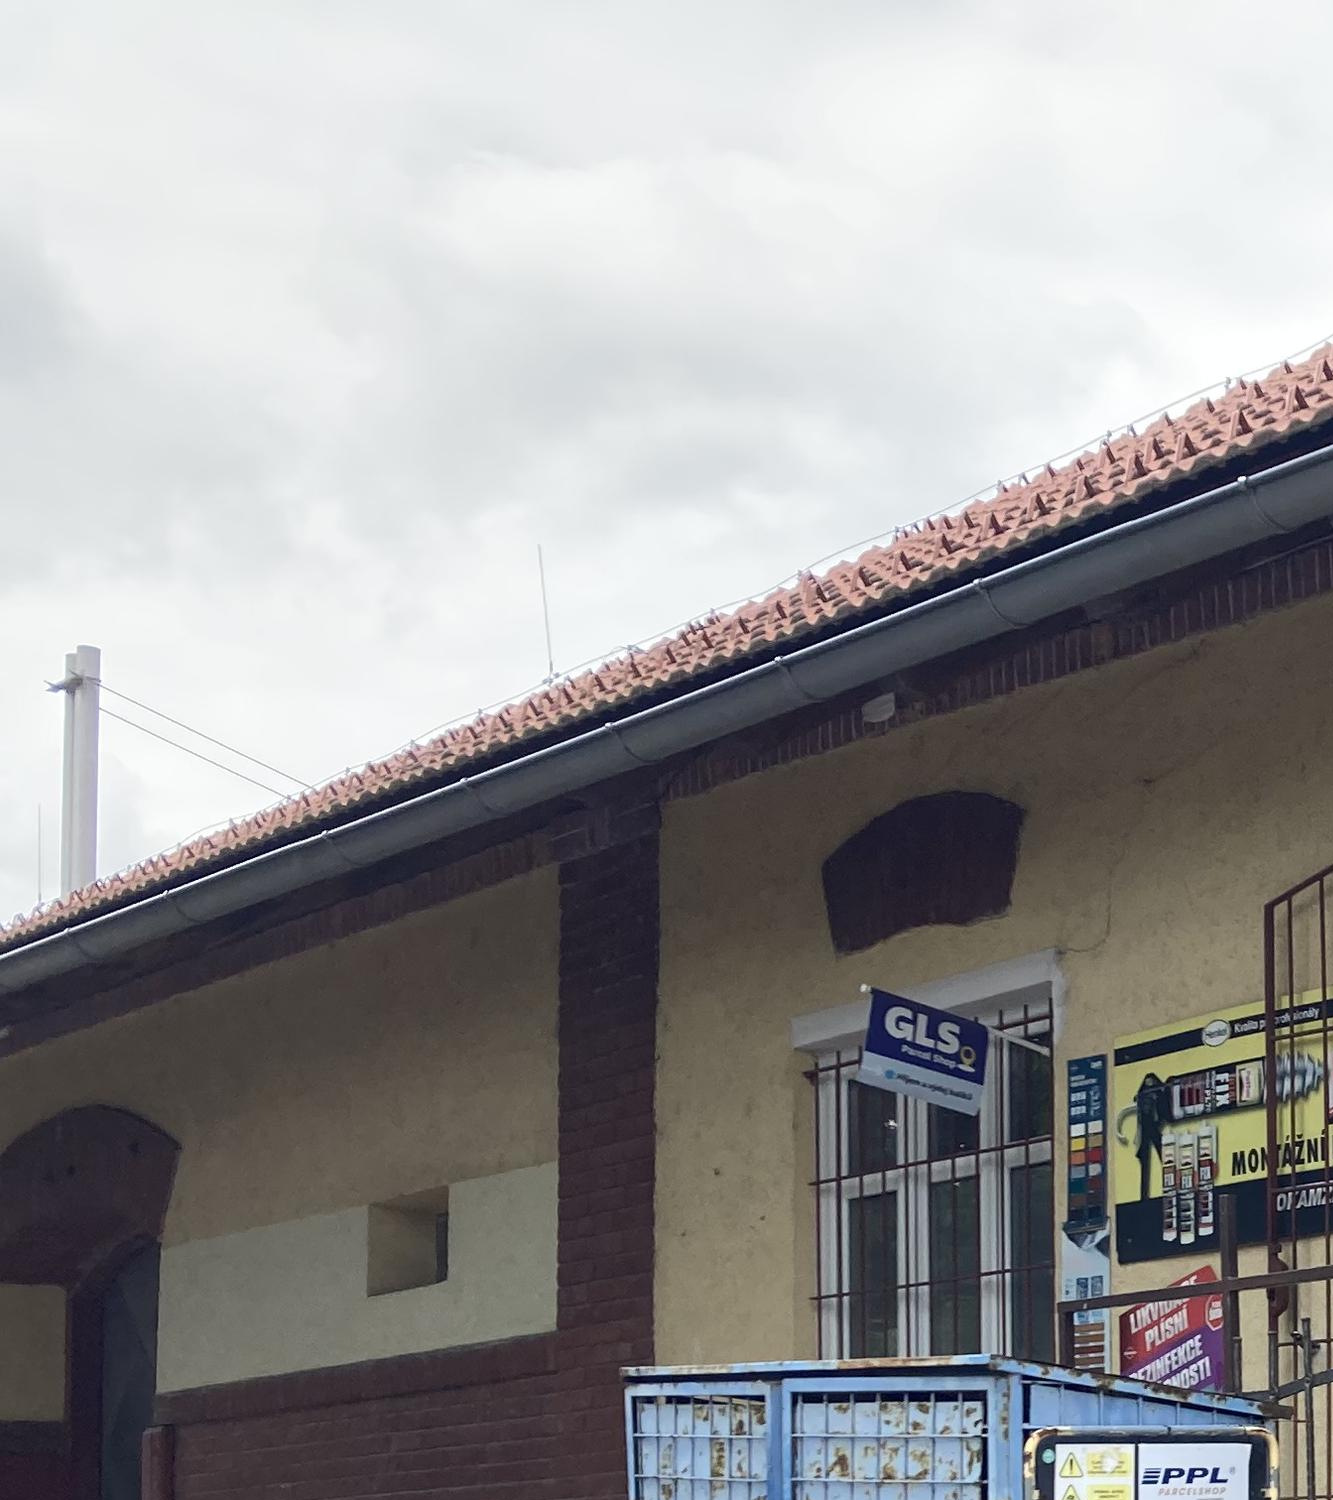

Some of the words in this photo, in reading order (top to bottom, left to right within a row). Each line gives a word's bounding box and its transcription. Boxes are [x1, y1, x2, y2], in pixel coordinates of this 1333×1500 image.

[885, 1006, 961, 1054] GLS
[1161, 1467, 1229, 1484] PPL
[1158, 1487, 1227, 1497] PARCELSHOP
